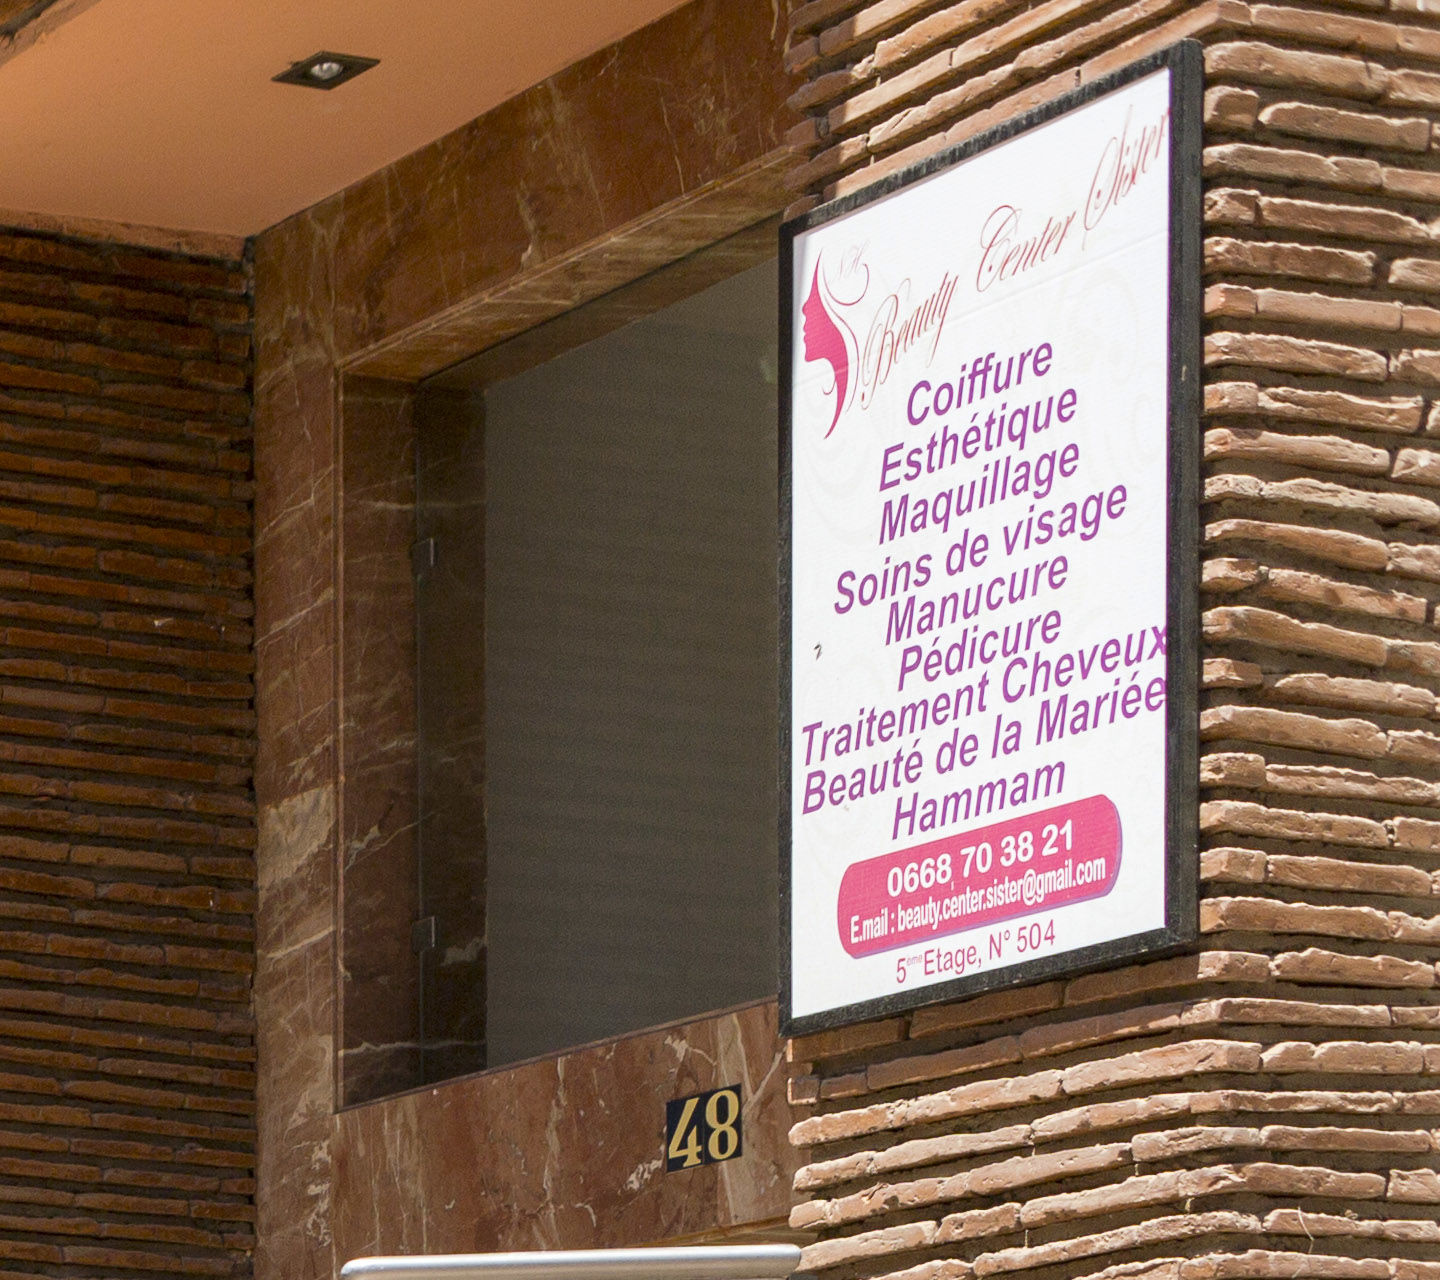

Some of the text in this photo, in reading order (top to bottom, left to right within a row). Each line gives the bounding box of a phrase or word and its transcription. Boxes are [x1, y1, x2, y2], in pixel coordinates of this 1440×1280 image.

[860, 271, 960, 411] Beauty
[976, 204, 1075, 292] Center
[907, 341, 1052, 425] Coiffure
[880, 387, 1077, 491] Esthétique
[879, 442, 1079, 545] Maquillage
[834, 485, 1127, 614] Soins de visage
[886, 555, 1068, 645] Manucure
[802, 625, 1167, 766] Traitement Cheveux
[898, 610, 1061, 691] Pédicure
[802, 671, 1167, 814] Beauté de la Mariée
[892, 761, 1065, 840] Hammam
[887, 820, 1072, 897] 0668 70 38 21
[1017, 920, 1055, 953] 504
[669, 1089, 739, 1167] 48
